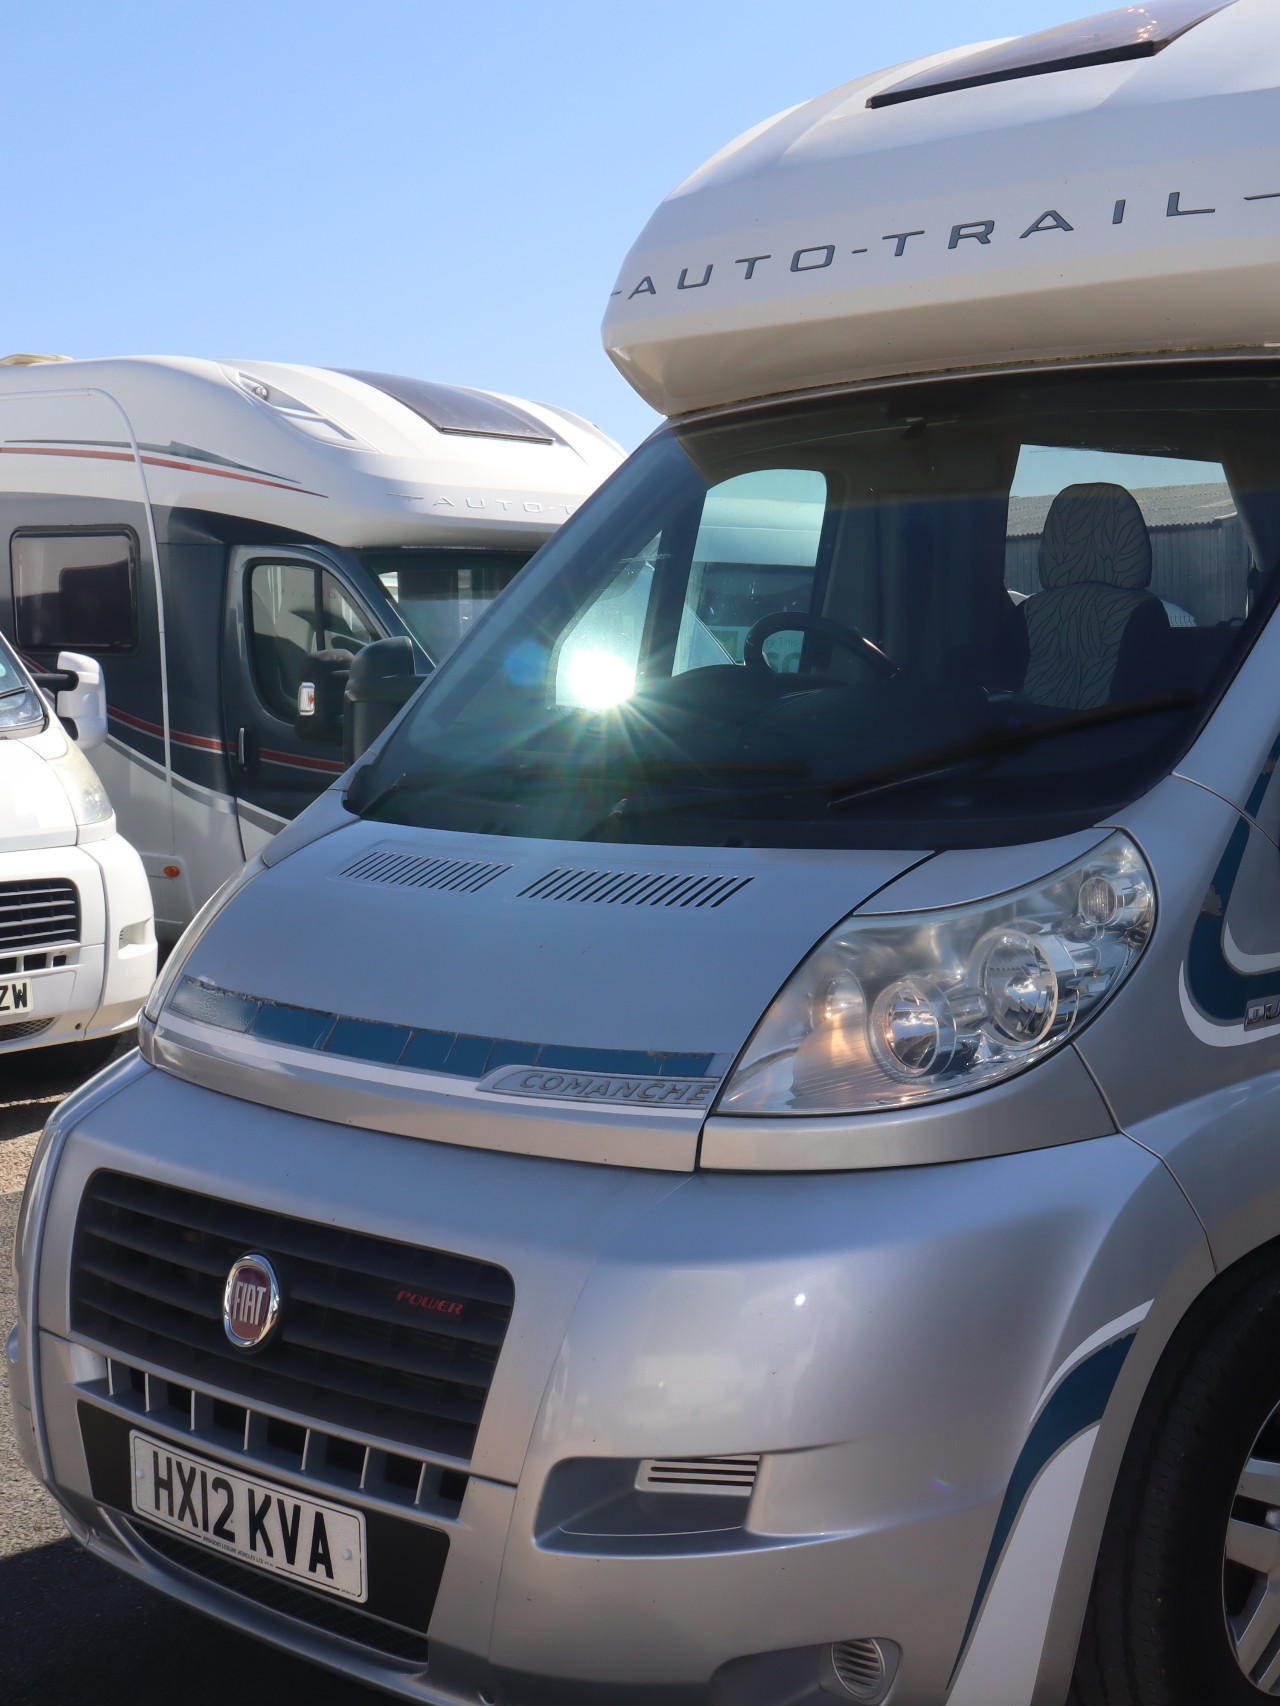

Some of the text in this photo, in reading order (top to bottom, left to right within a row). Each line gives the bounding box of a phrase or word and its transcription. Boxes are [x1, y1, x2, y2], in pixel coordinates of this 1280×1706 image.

[628, 191, 1216, 300] AUTO-TRAIL
[519, 1072, 716, 1102] COMANCHE
[232, 1281, 267, 1326] FIAT
[396, 1290, 464, 1316] POWER
[152, 1450, 335, 1580] HX12 KVA
